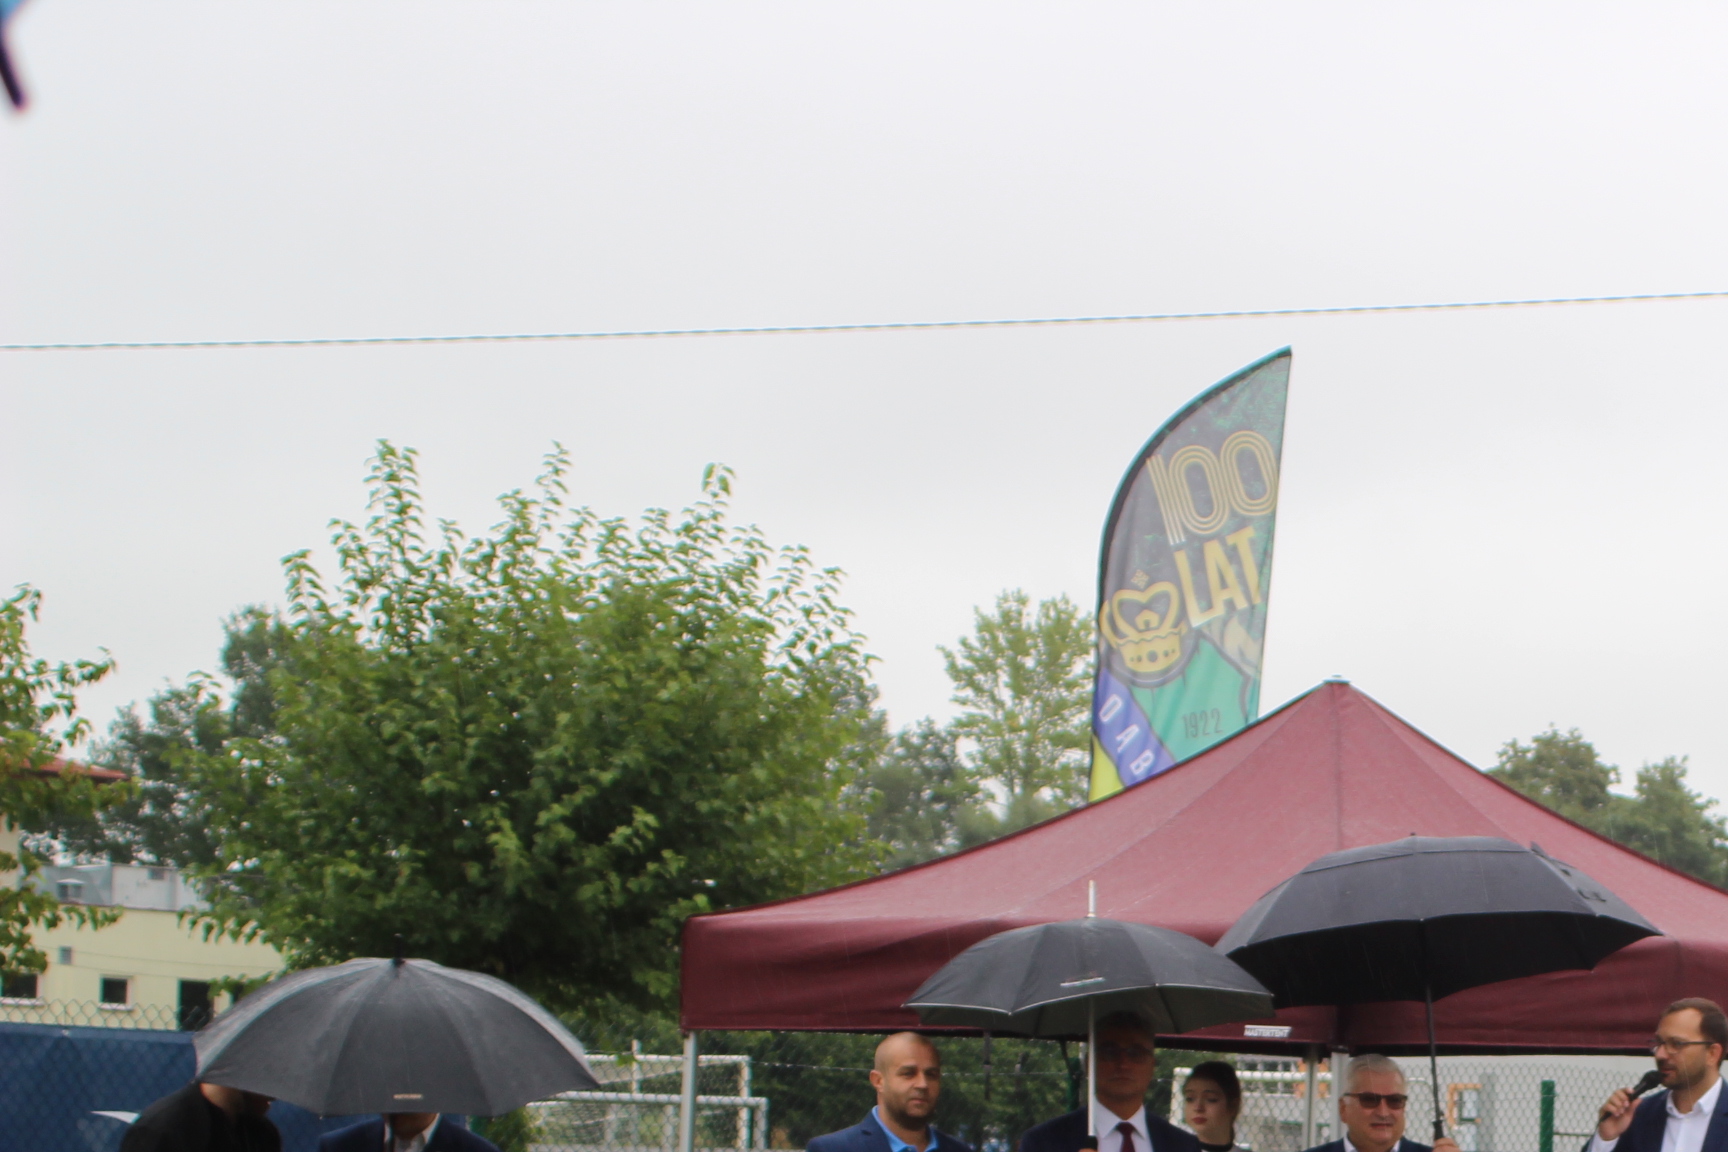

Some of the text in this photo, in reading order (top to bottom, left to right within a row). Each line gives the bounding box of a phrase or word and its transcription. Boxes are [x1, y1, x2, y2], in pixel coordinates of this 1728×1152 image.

[1146, 430, 1279, 546] 100
[1174, 526, 1262, 628] LAT
[1182, 709, 1224, 740] 1922
